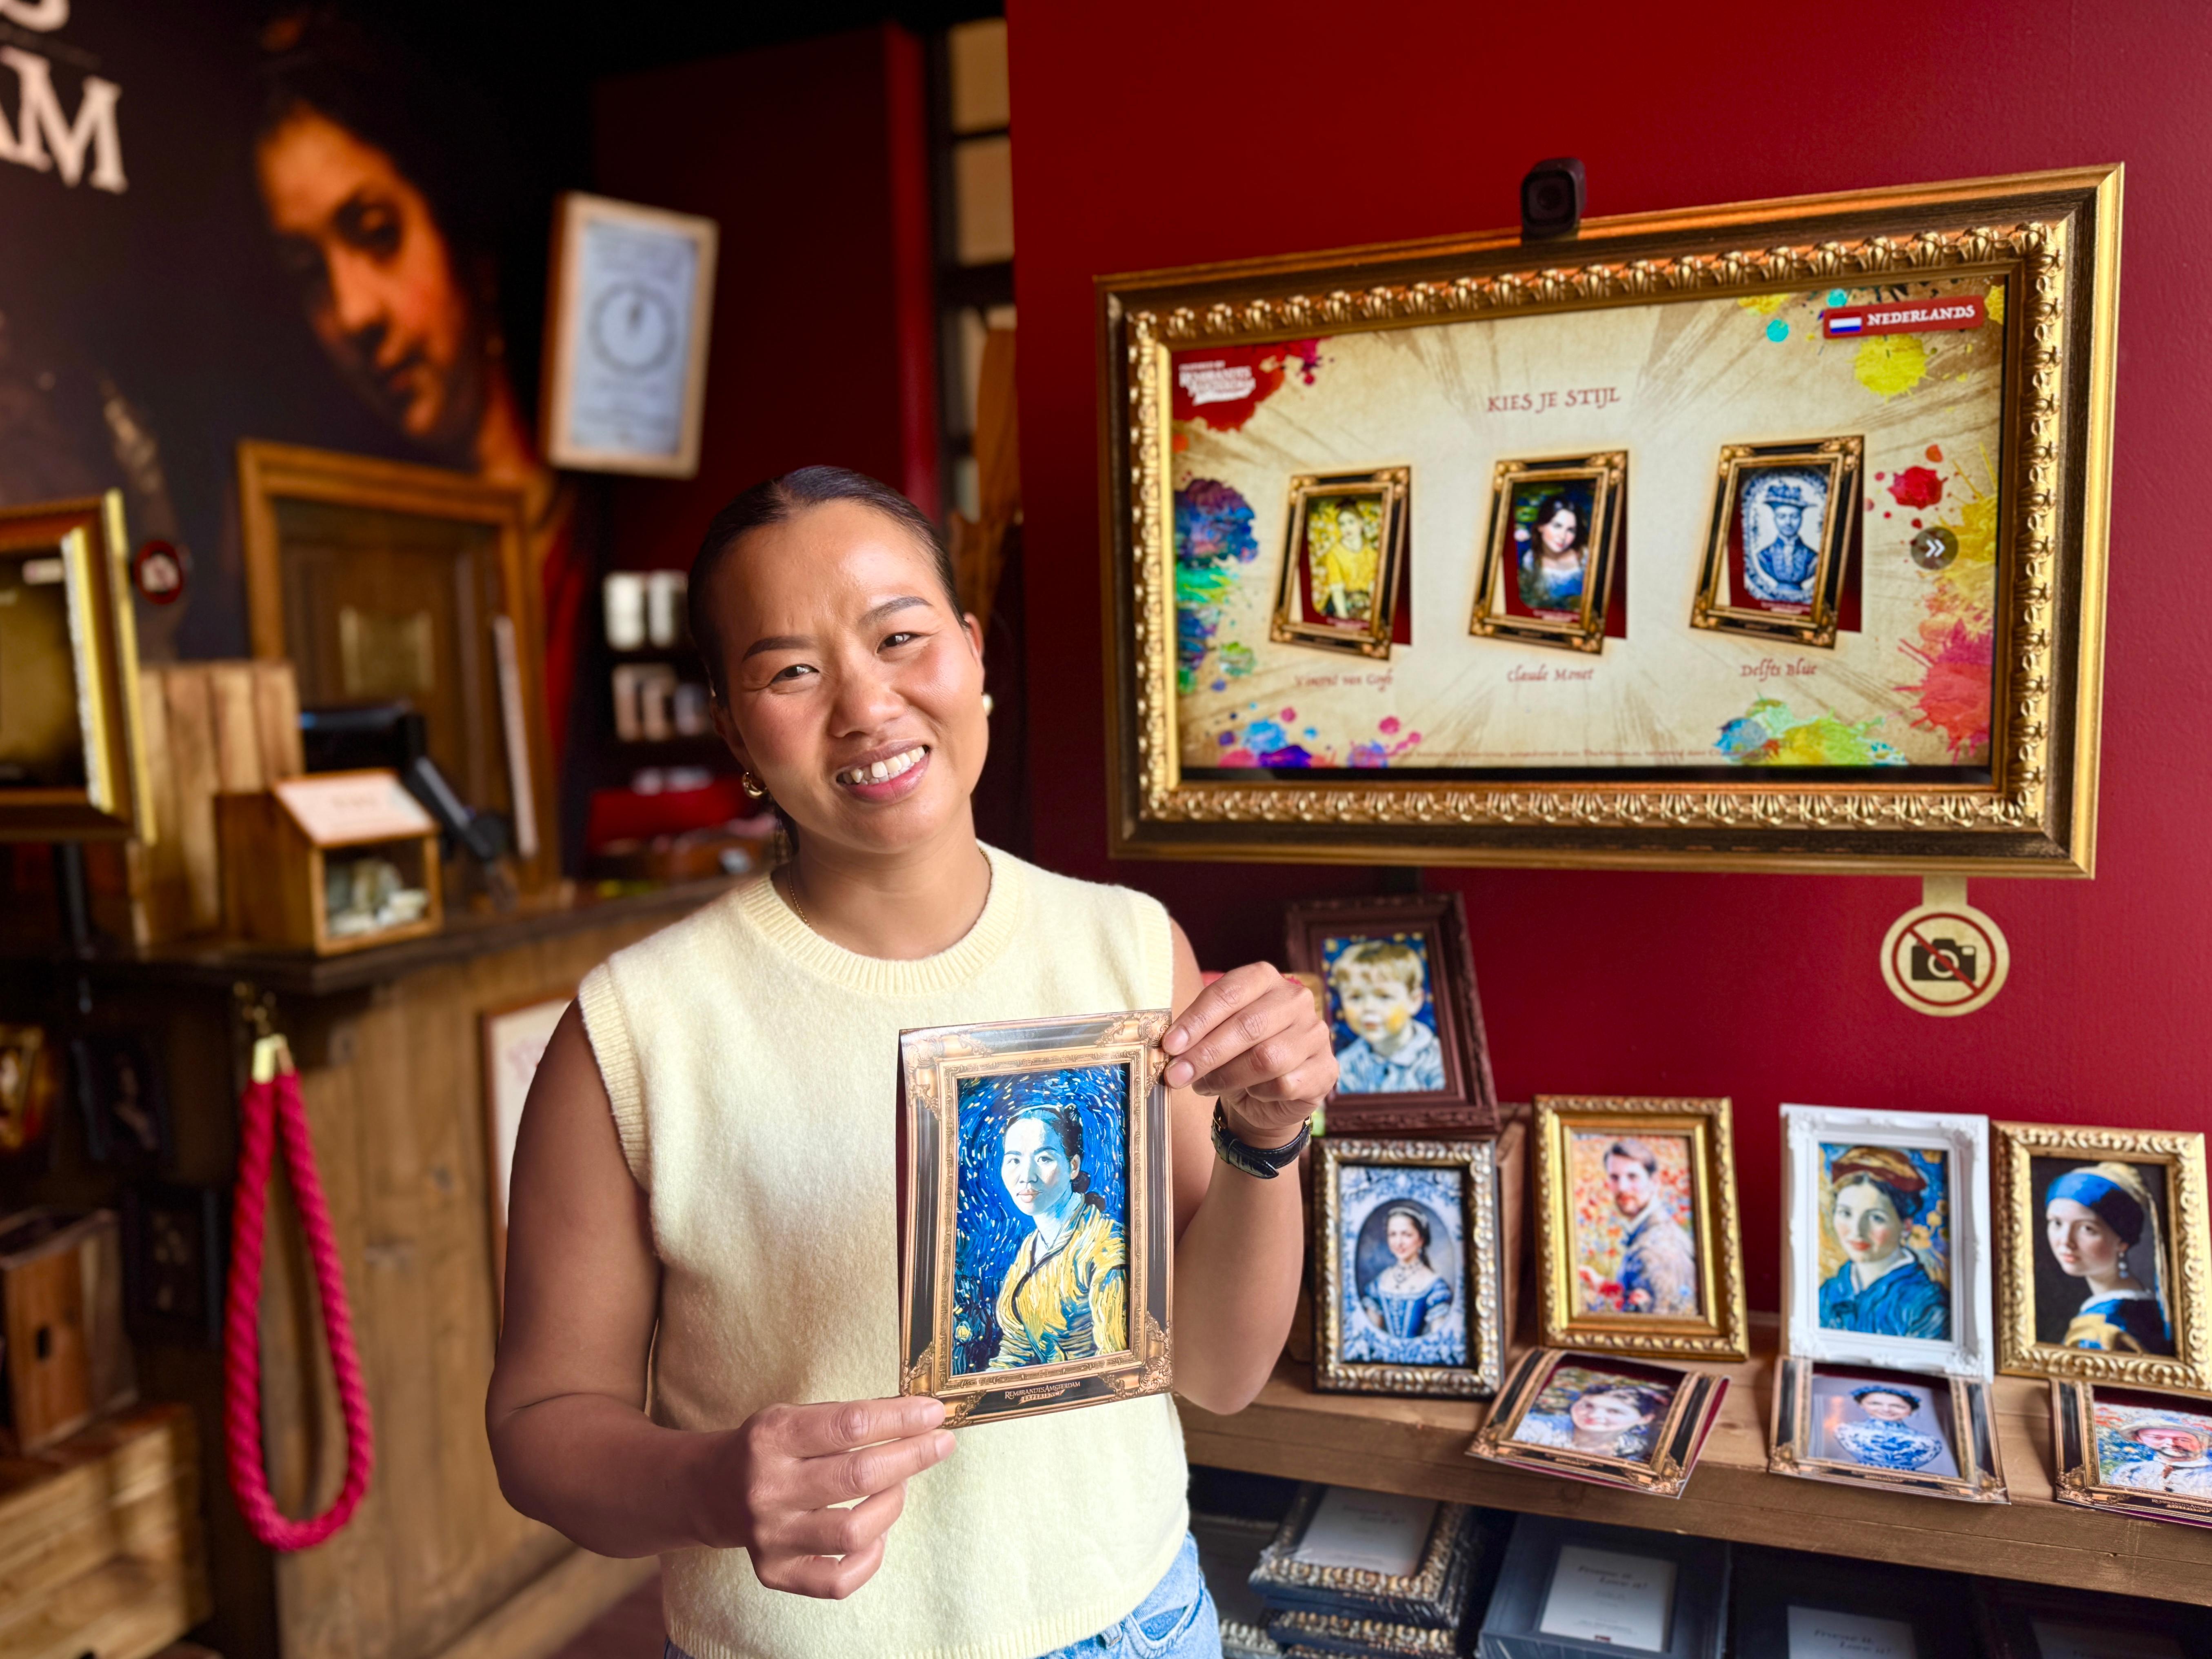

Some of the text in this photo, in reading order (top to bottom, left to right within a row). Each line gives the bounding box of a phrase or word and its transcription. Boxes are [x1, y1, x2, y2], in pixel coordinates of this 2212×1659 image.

[1867, 304, 1975, 326] NEDERLANDS
[1487, 386, 1621, 413] KIES JE STIJL
[1506, 664, 1595, 683] Claude Monet
[1741, 658, 1781, 682] Delfts
